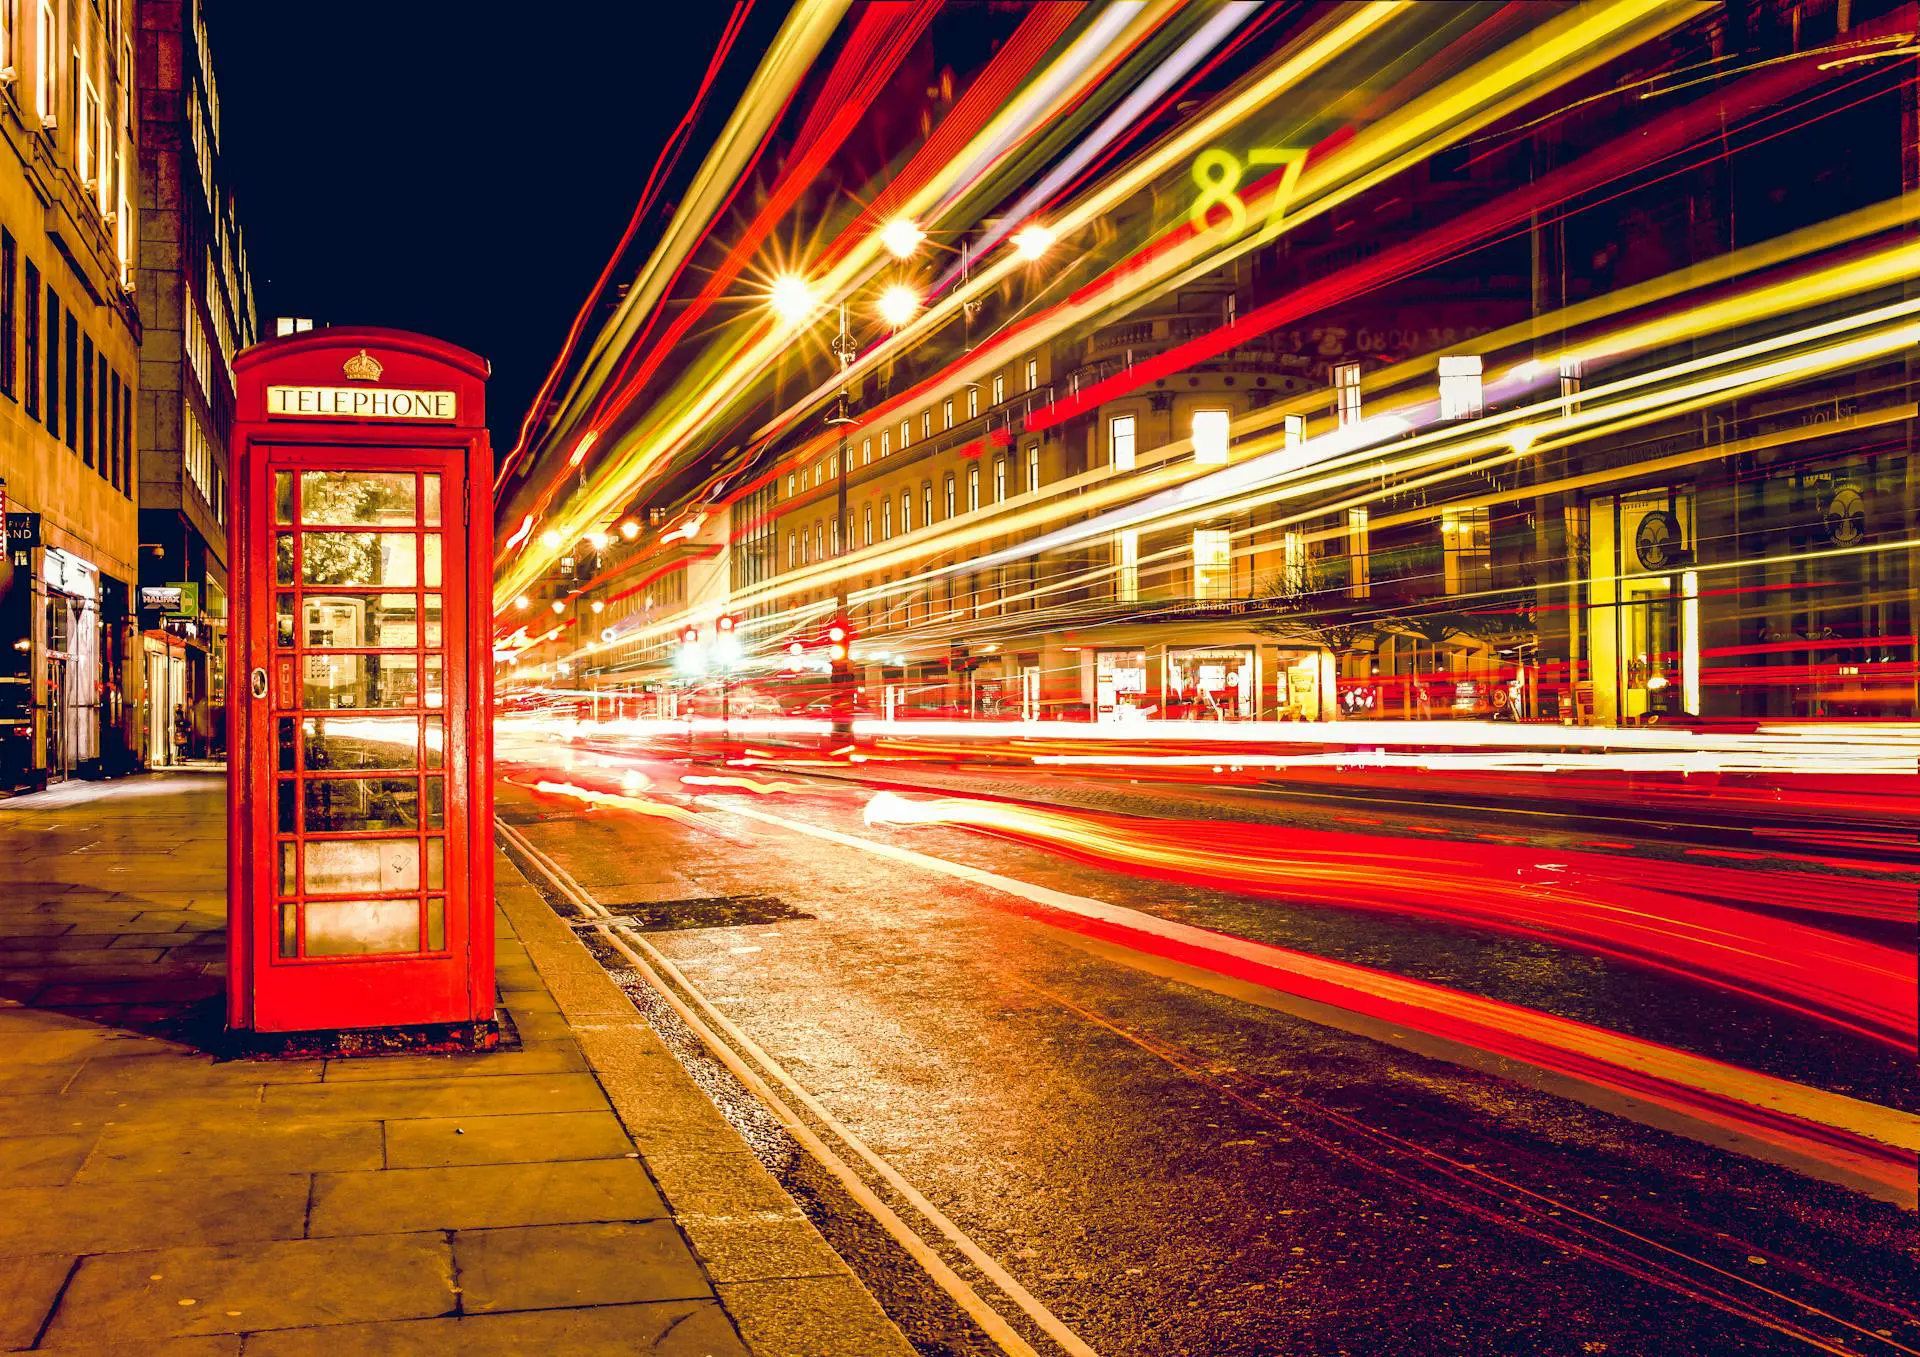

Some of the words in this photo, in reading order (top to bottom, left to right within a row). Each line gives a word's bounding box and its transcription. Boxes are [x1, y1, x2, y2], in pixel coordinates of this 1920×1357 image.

[1190, 148, 1309, 244] 87
[275, 389, 449, 416] TELEPHONE
[143, 595, 181, 603] HALIFAX
[282, 663, 290, 704] PULL
